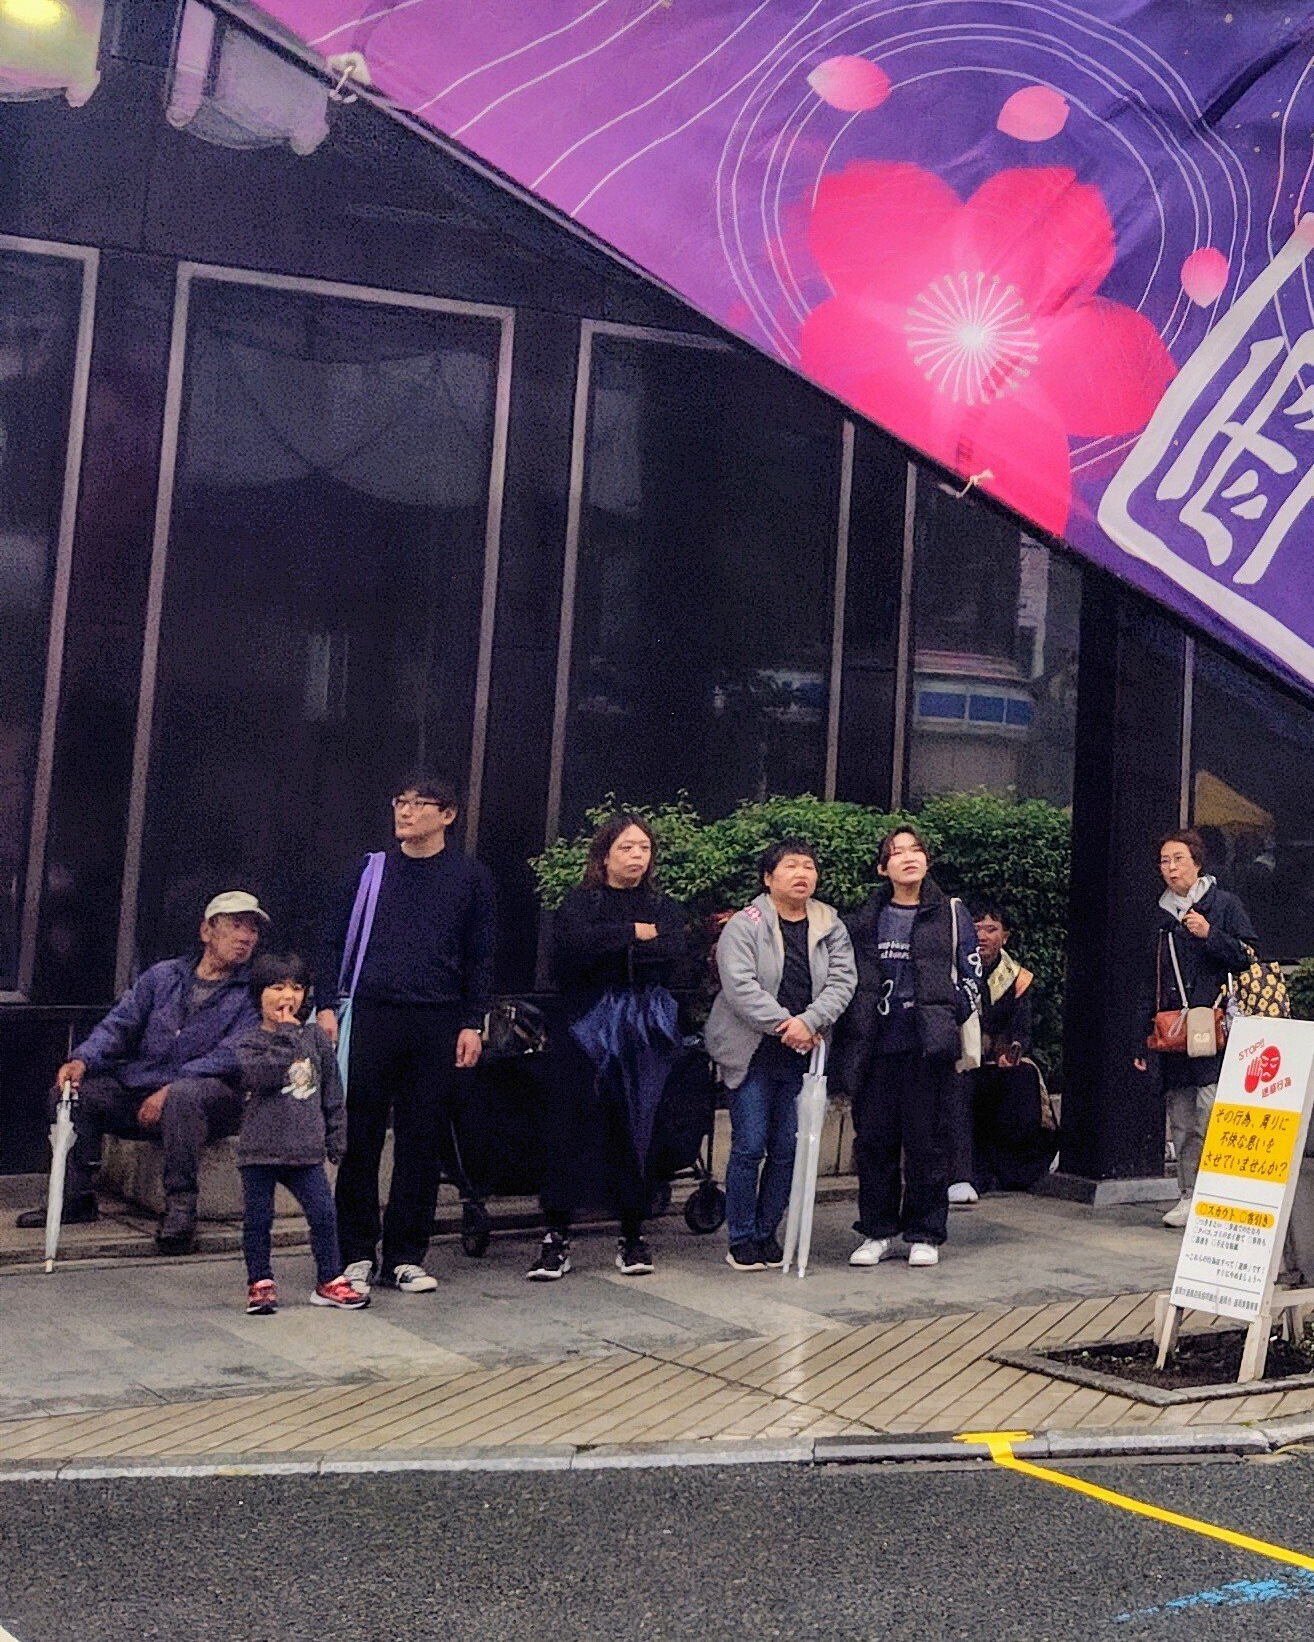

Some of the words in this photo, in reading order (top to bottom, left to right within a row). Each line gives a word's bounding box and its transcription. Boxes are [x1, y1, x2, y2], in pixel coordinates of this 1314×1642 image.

[1260, 1076, 1293, 1099] 迷惑行為
[1215, 1108, 1290, 1131] その行為、周りに
[1219, 1130, 1276, 1153] 不快な思いを
